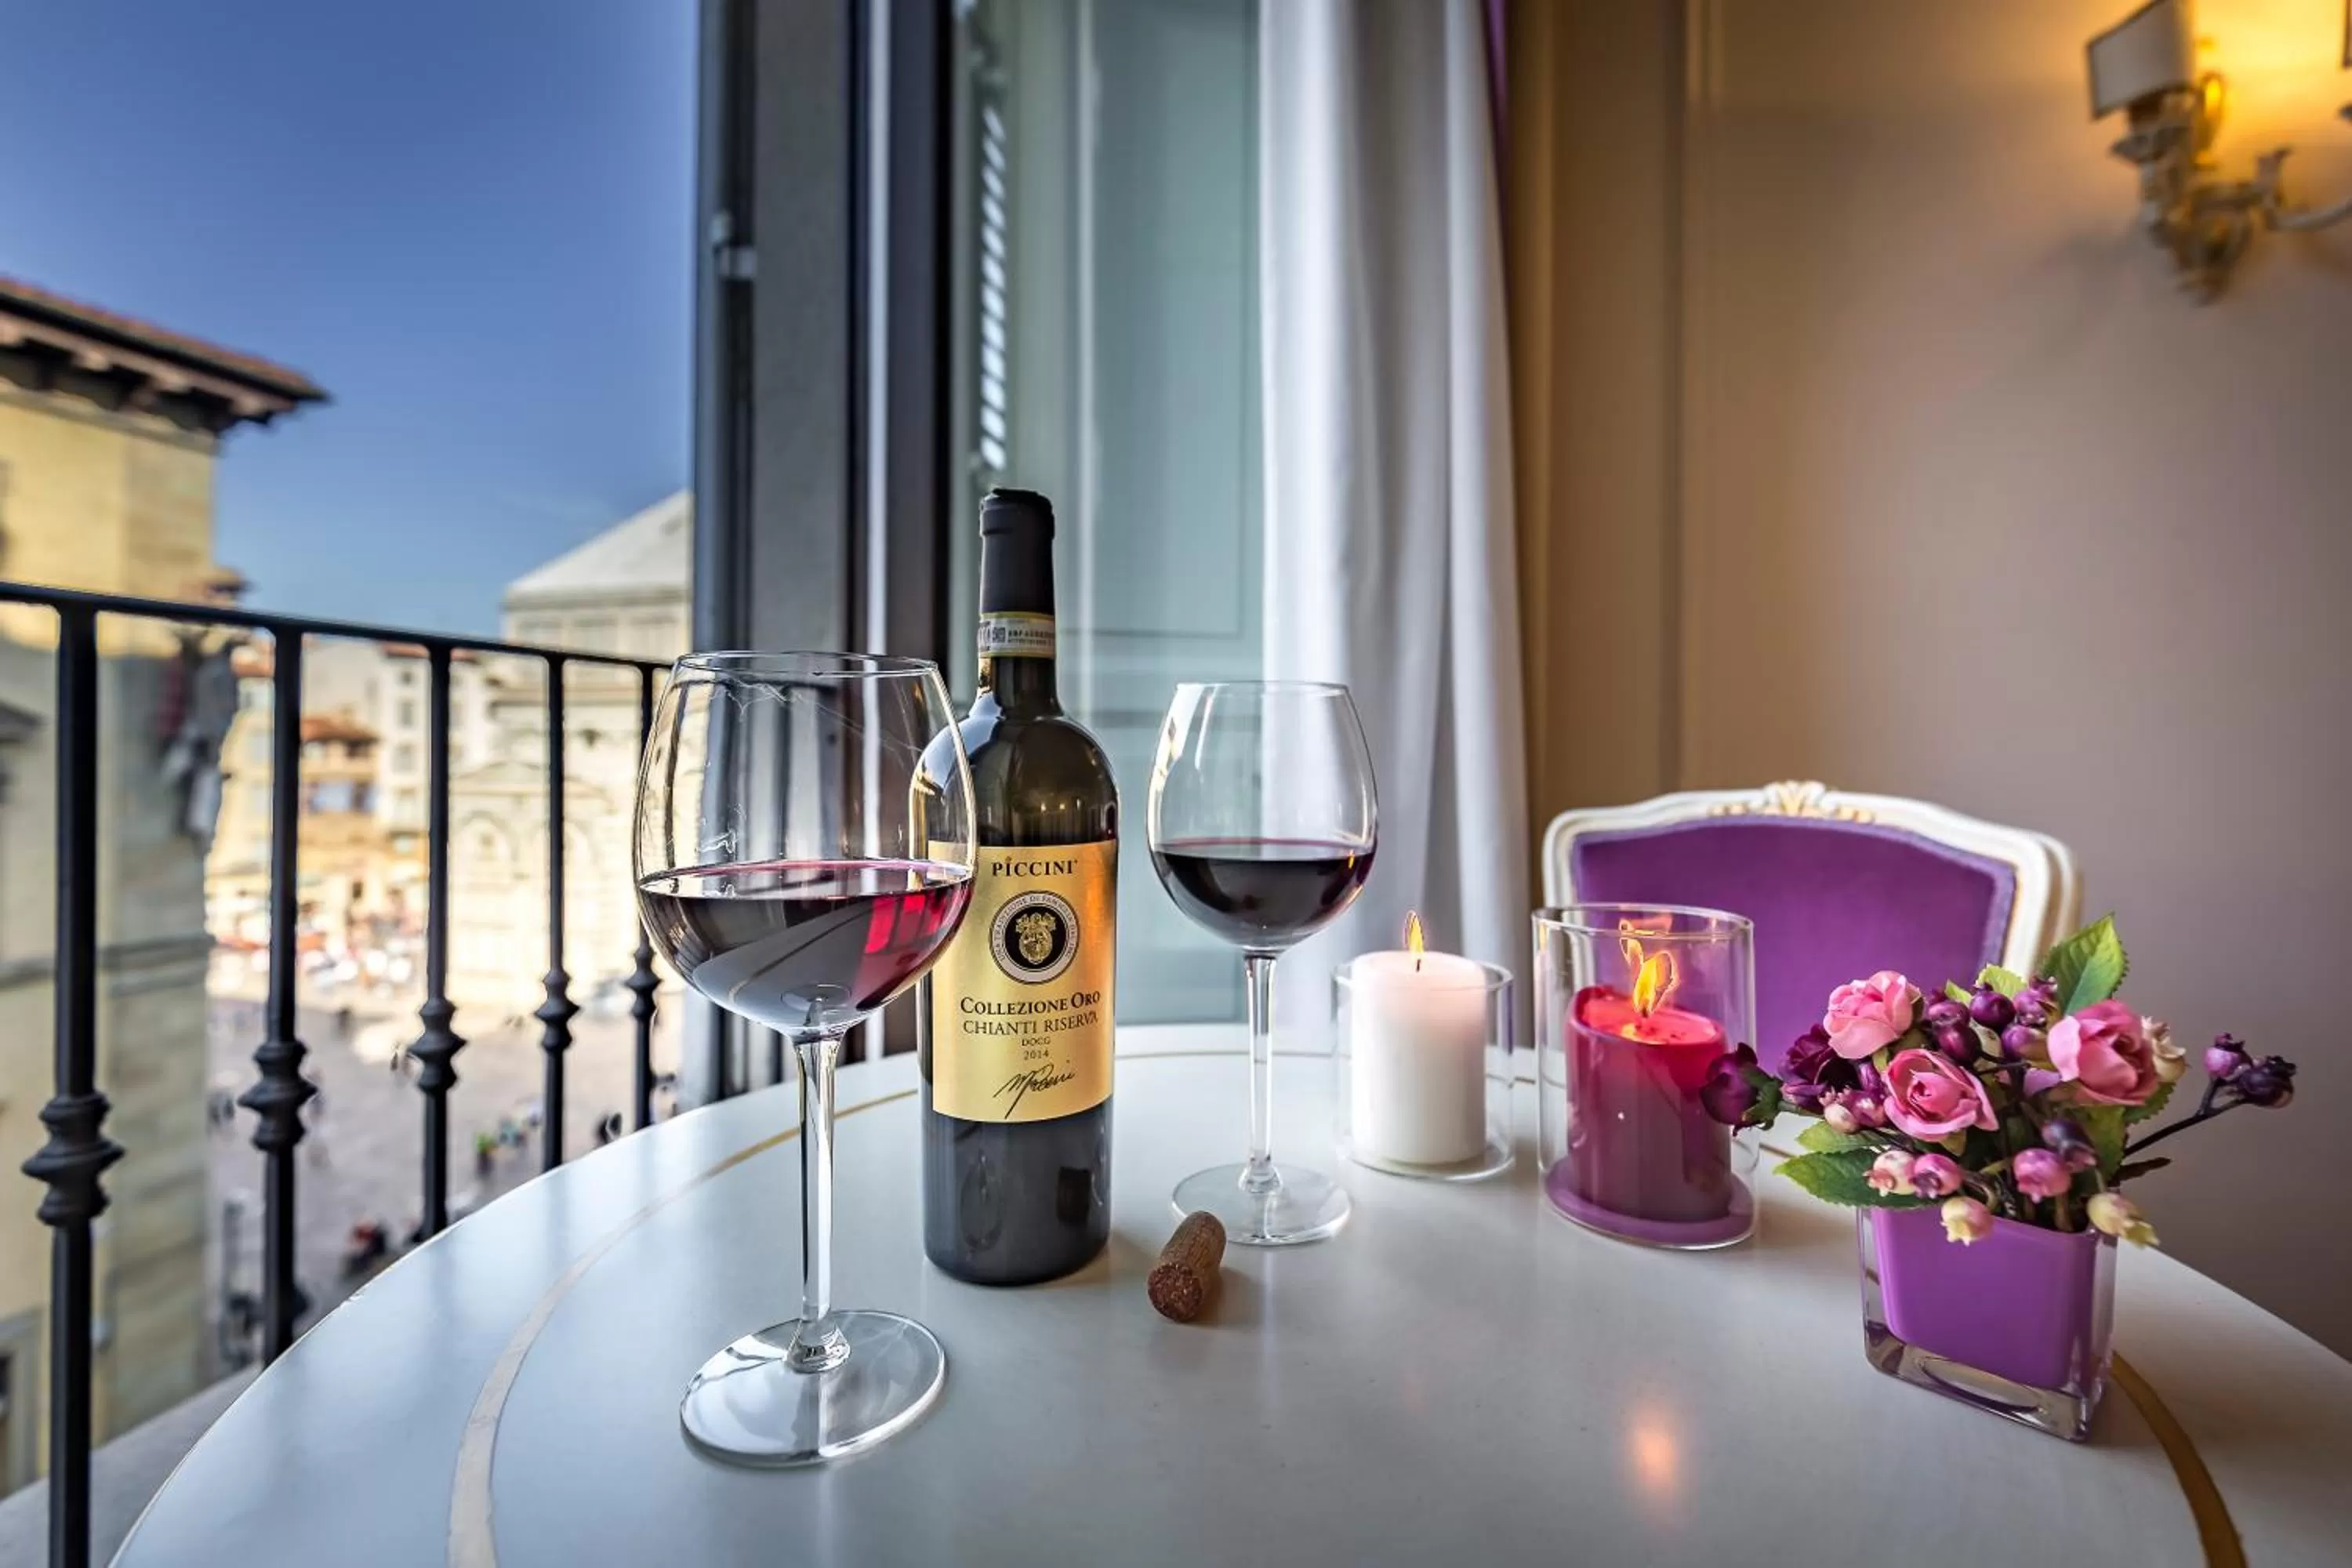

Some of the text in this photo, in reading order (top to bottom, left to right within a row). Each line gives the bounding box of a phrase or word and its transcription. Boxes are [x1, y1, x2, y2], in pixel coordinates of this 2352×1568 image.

[963, 1011, 1098, 1036] CHIANTI RISERVA
[1022, 1036, 1051, 1047] DOCG
[1023, 1049, 1049, 1061] 2014
